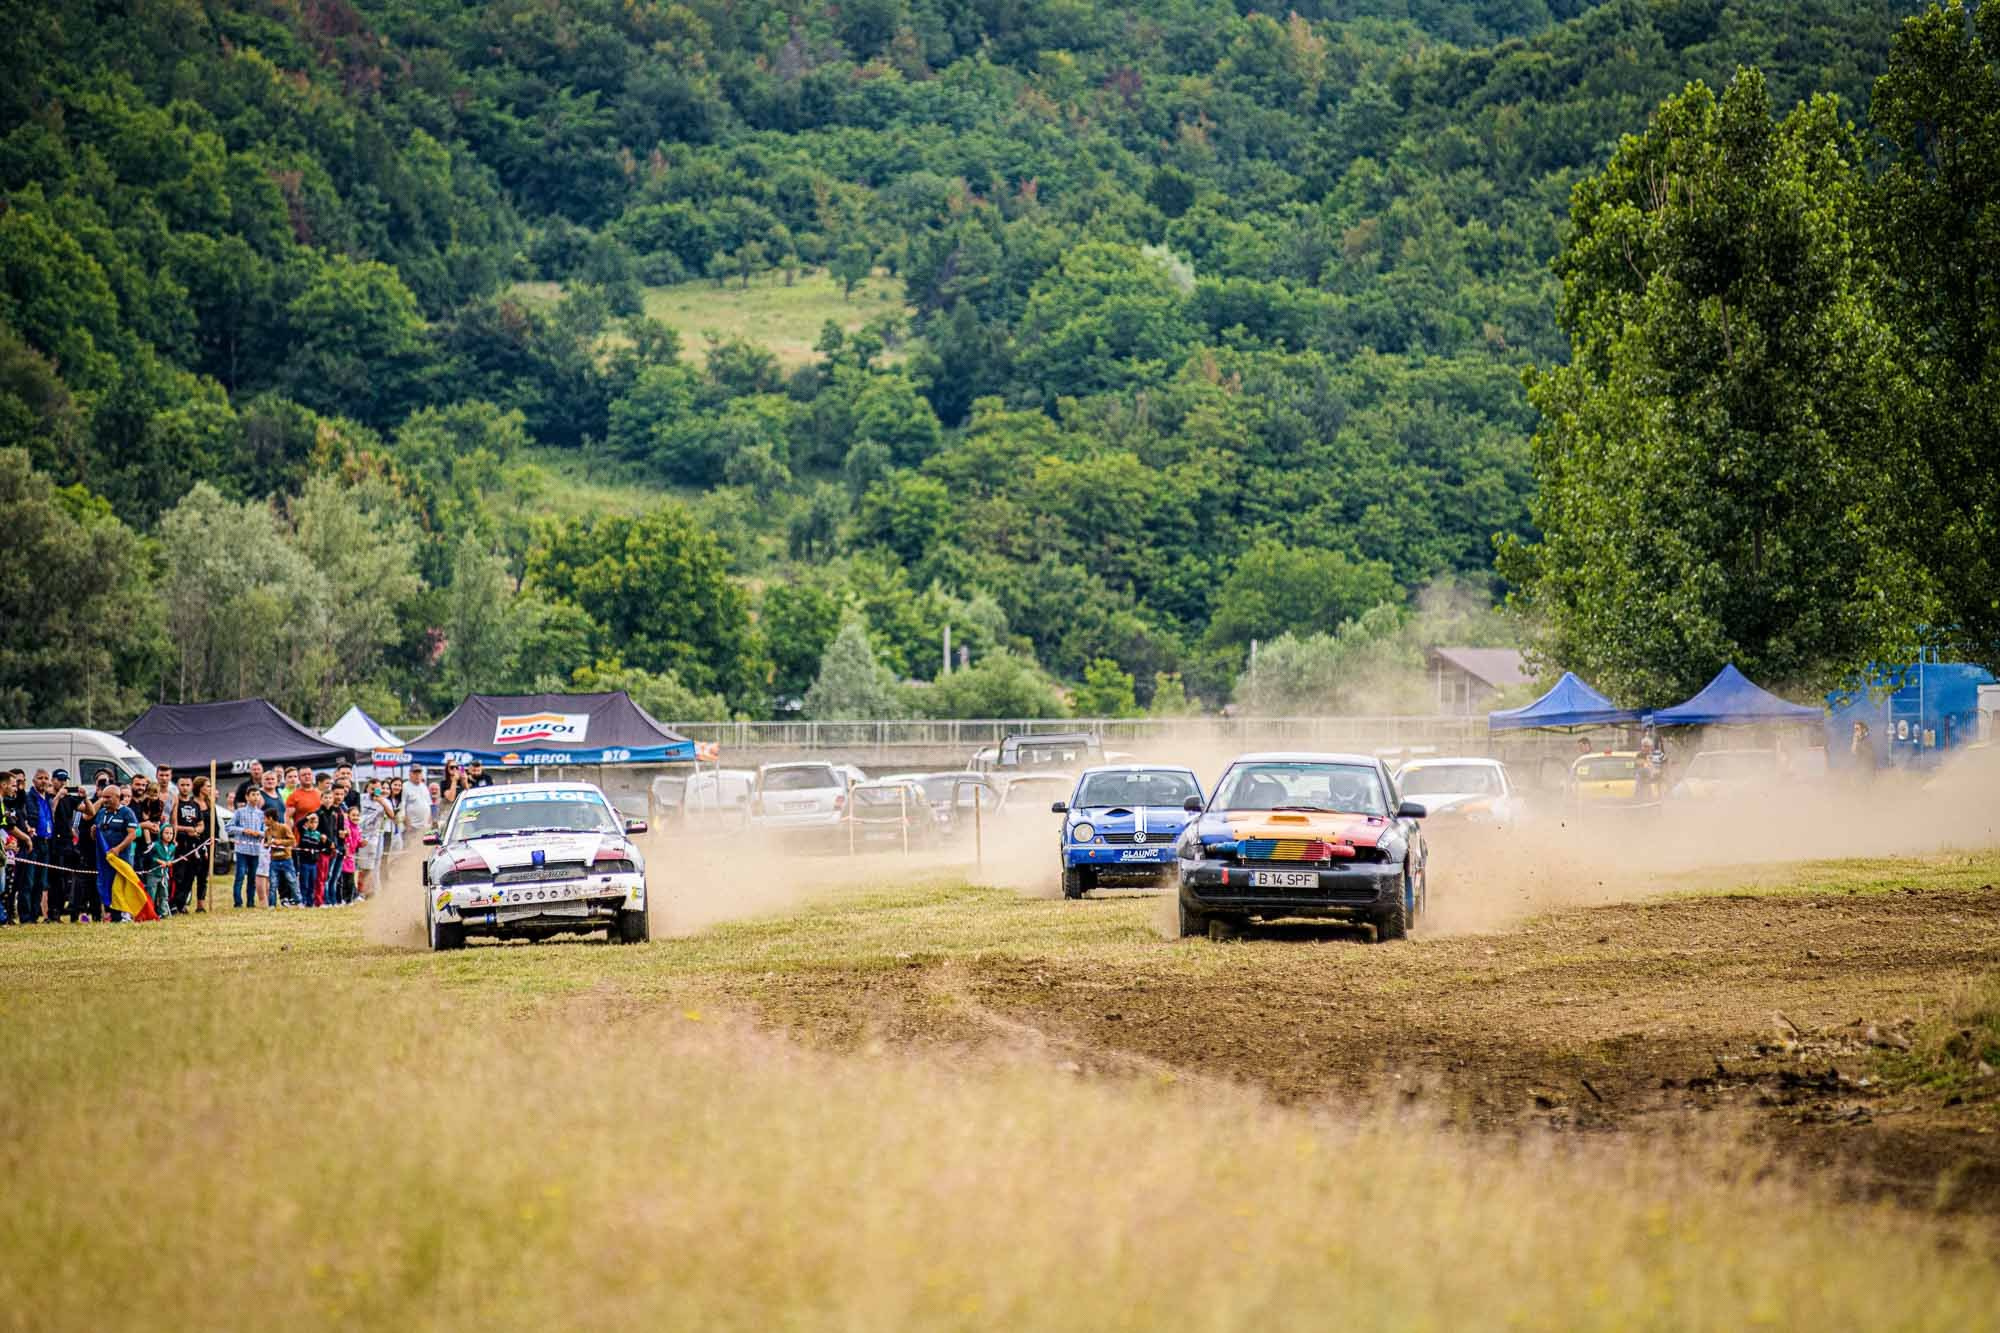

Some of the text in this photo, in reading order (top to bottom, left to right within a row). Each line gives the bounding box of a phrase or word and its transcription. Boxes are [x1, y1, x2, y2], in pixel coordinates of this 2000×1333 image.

[501, 723, 576, 736] REPSOL
[523, 753, 573, 764] REPSOL
[1122, 849, 1159, 858] CLAUNIC
[1259, 873, 1313, 886] B 14 SPF
